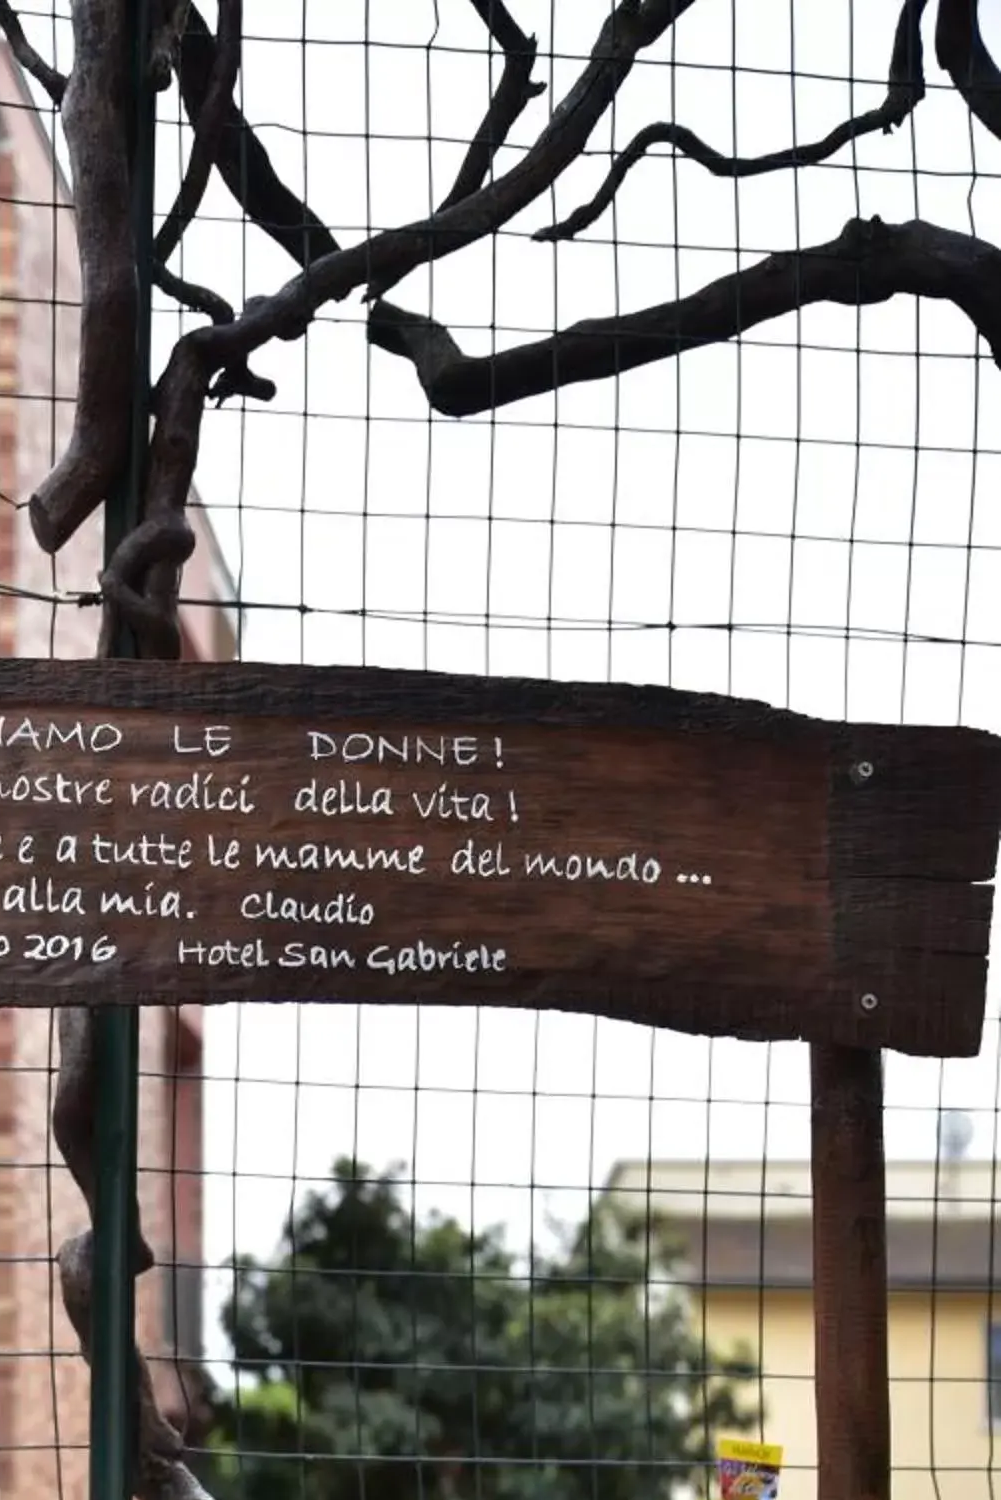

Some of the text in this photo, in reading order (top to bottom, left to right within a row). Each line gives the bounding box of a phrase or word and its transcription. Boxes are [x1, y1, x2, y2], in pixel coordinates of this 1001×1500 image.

[173, 724, 232, 757] LE
[130, 771, 256, 814] radici
[294, 778, 394, 817] della
[55, 834, 78, 864] a
[91, 833, 193, 869] tutte
[207, 834, 240, 870] le
[255, 843, 426, 875] mamme
[450, 838, 511, 878] del
[2, 876, 86, 916] alla
[100, 881, 195, 919] mia.
[240, 890, 375, 926] Claudio
[22, 933, 118, 963] 2016
[178, 938, 270, 968] Hotel
[277, 942, 356, 969] San
[366, 939, 507, 976] Gabriele
